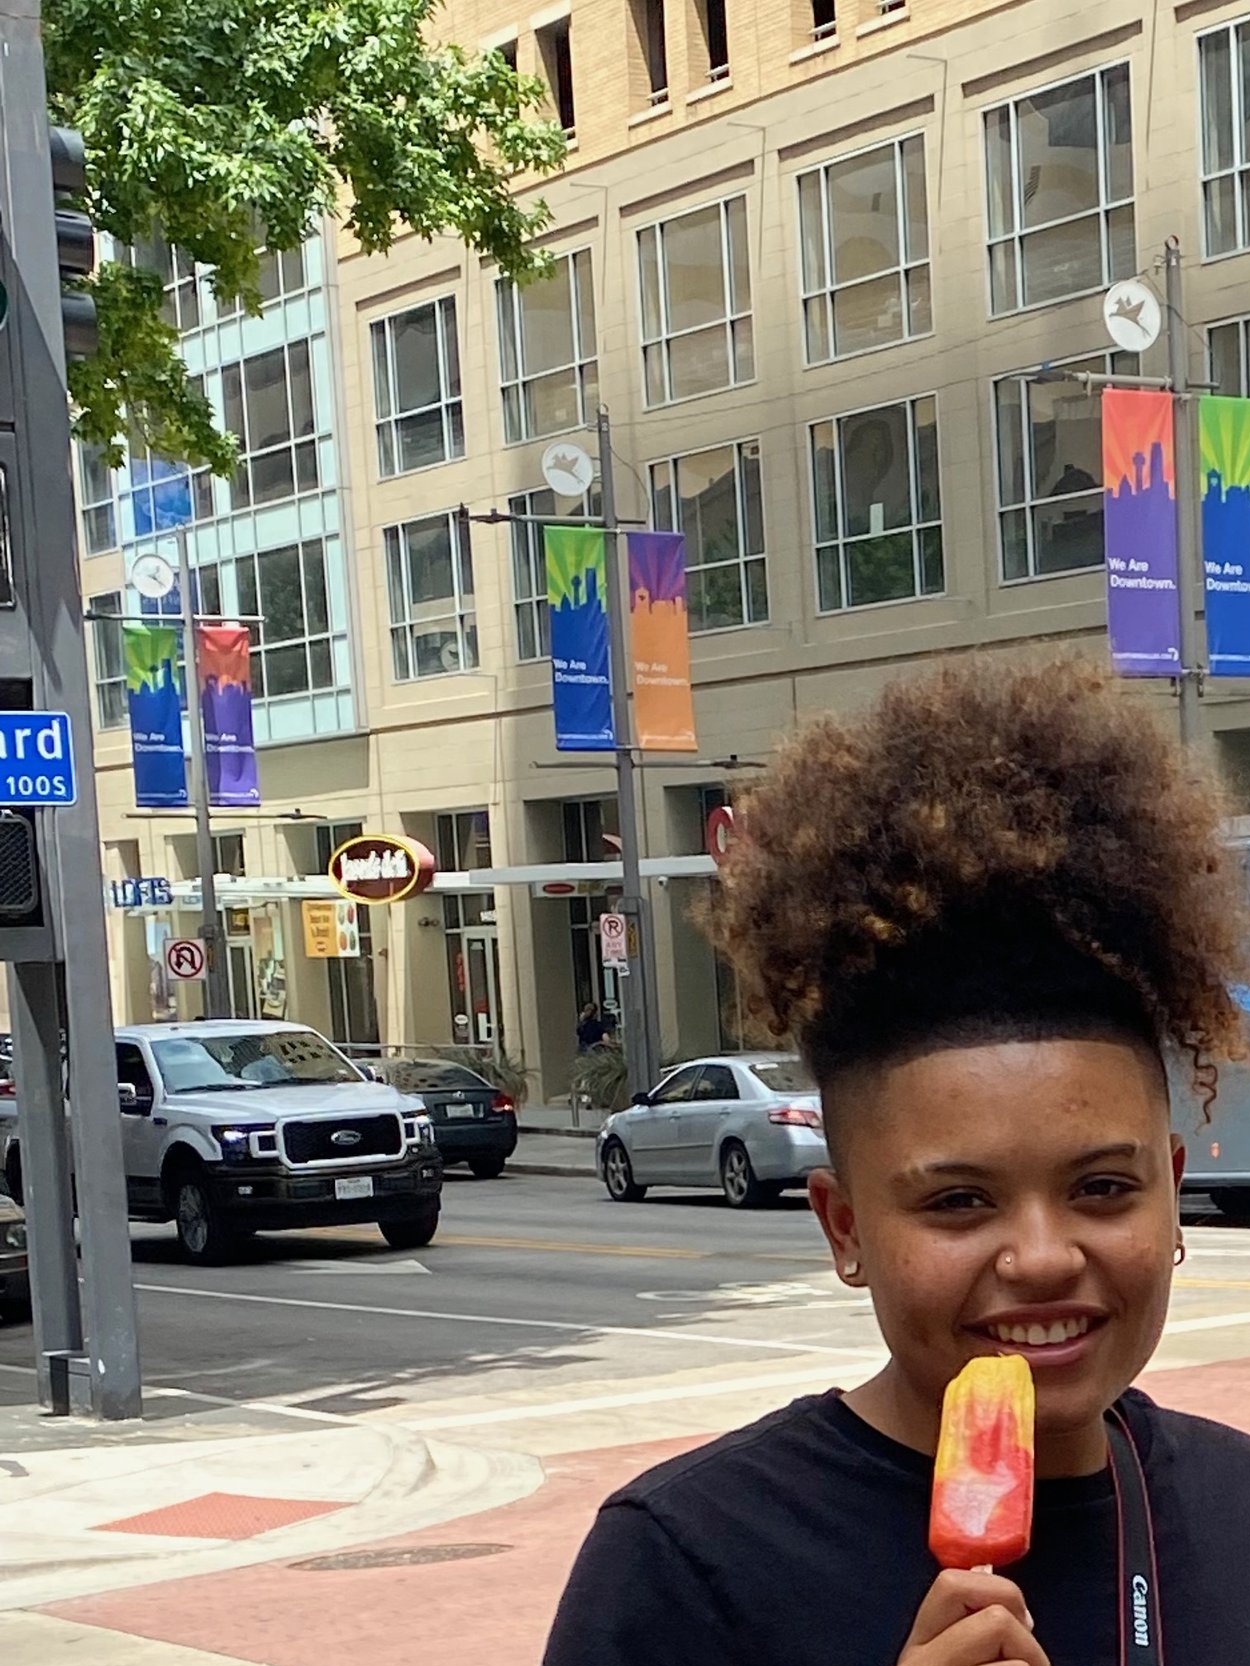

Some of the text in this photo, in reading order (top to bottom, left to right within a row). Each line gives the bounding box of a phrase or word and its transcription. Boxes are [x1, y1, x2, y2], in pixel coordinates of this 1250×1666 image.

[1108, 558, 1149, 572] We Are
[1205, 561, 1243, 575] We Are
[6, 776, 67, 797] 100S
[1132, 1574, 1150, 1647] Canon
